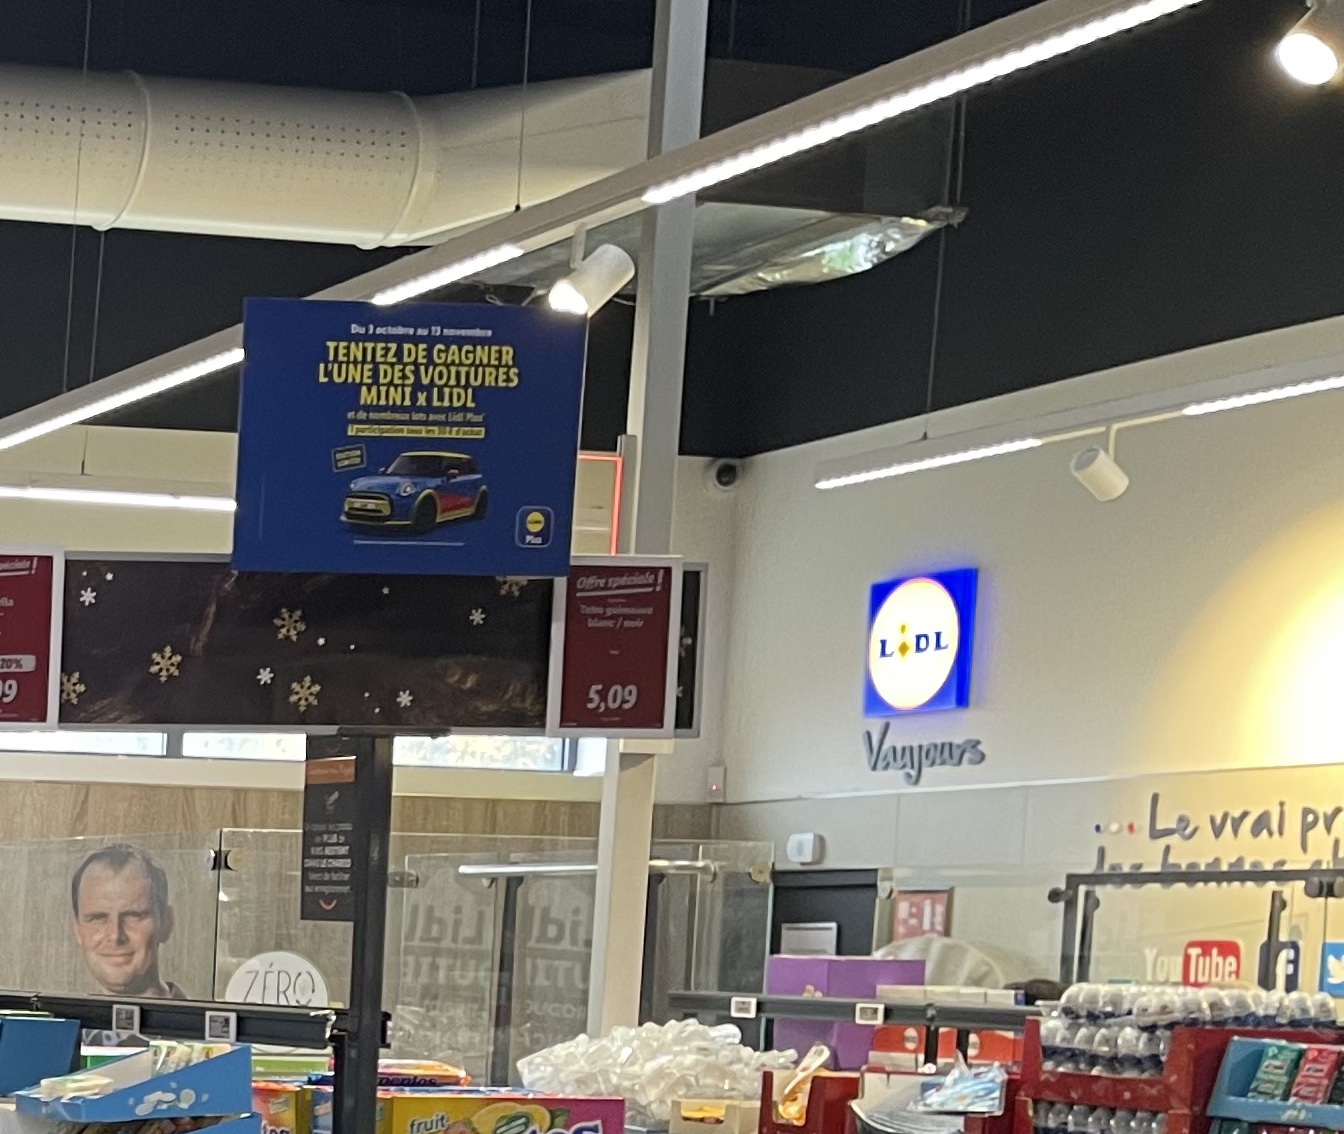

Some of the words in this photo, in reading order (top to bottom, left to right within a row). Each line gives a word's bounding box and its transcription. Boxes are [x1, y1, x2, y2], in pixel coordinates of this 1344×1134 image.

[326, 341, 398, 363] TENTEZ
[403, 343, 427, 363] DE
[433, 343, 514, 366] GAGNER
[318, 363, 374, 383] L'UNE
[378, 364, 415, 384] DES
[419, 365, 519, 388] VOITURES
[360, 385, 412, 406] MINI
[416, 391, 427, 406] x
[432, 386, 476, 408] LIDL
[878, 623, 949, 658] LIDL
[586, 684, 638, 713] 5,09
[1149, 792, 1200, 840] Le
[1209, 800, 1287, 840] vrai
